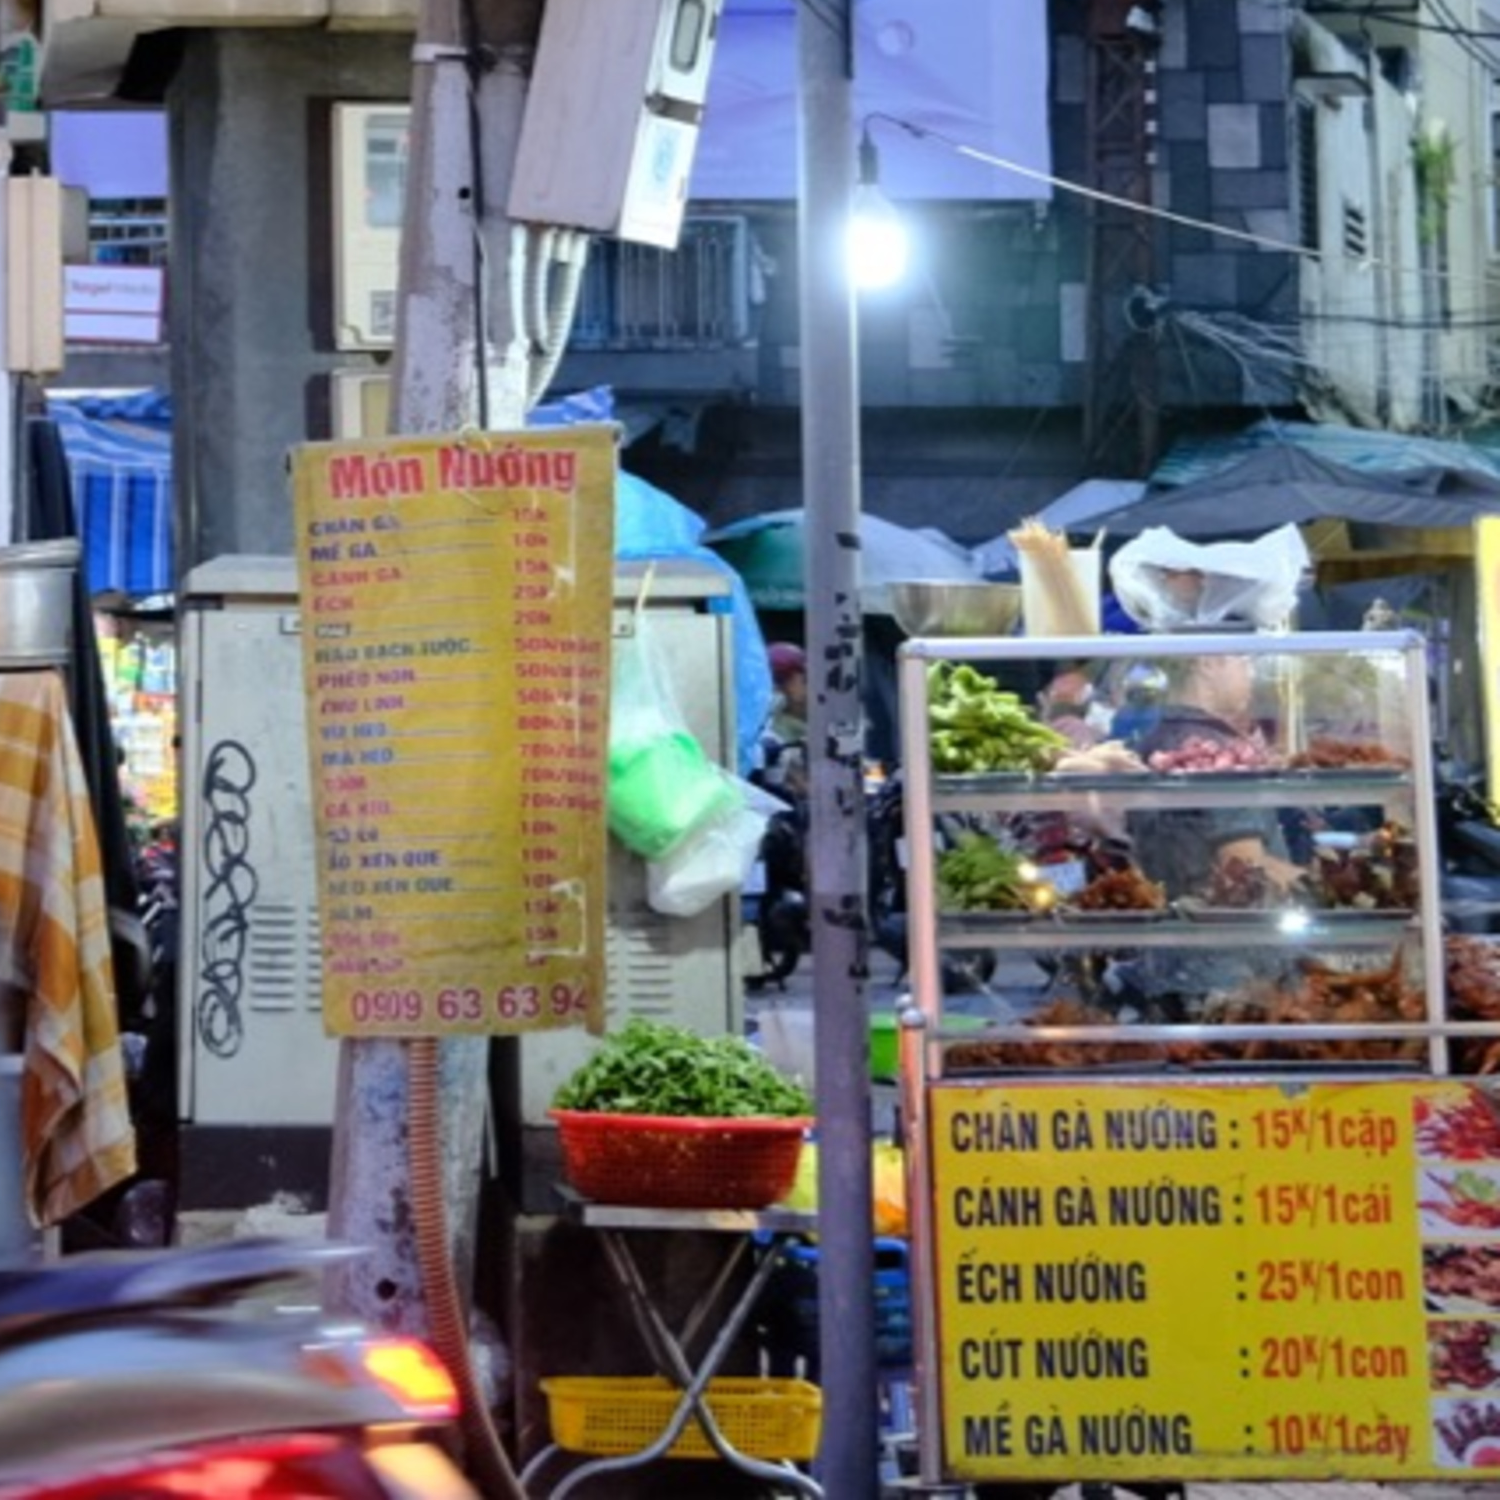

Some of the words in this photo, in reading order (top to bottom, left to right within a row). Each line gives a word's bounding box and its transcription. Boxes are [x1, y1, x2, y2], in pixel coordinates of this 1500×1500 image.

[436, 987, 482, 1021] 63
[496, 985, 541, 1019] 63
[950, 1101, 1039, 1152] CHÂN
[1052, 1100, 1095, 1151] GÀ
[953, 1175, 1044, 1229] CÁNH
[1054, 1175, 1099, 1227] GÀ
[956, 1247, 1023, 1303] ẾCH
[960, 1328, 1024, 1380] CÚT
[1024, 1403, 1070, 1457] GÀ
